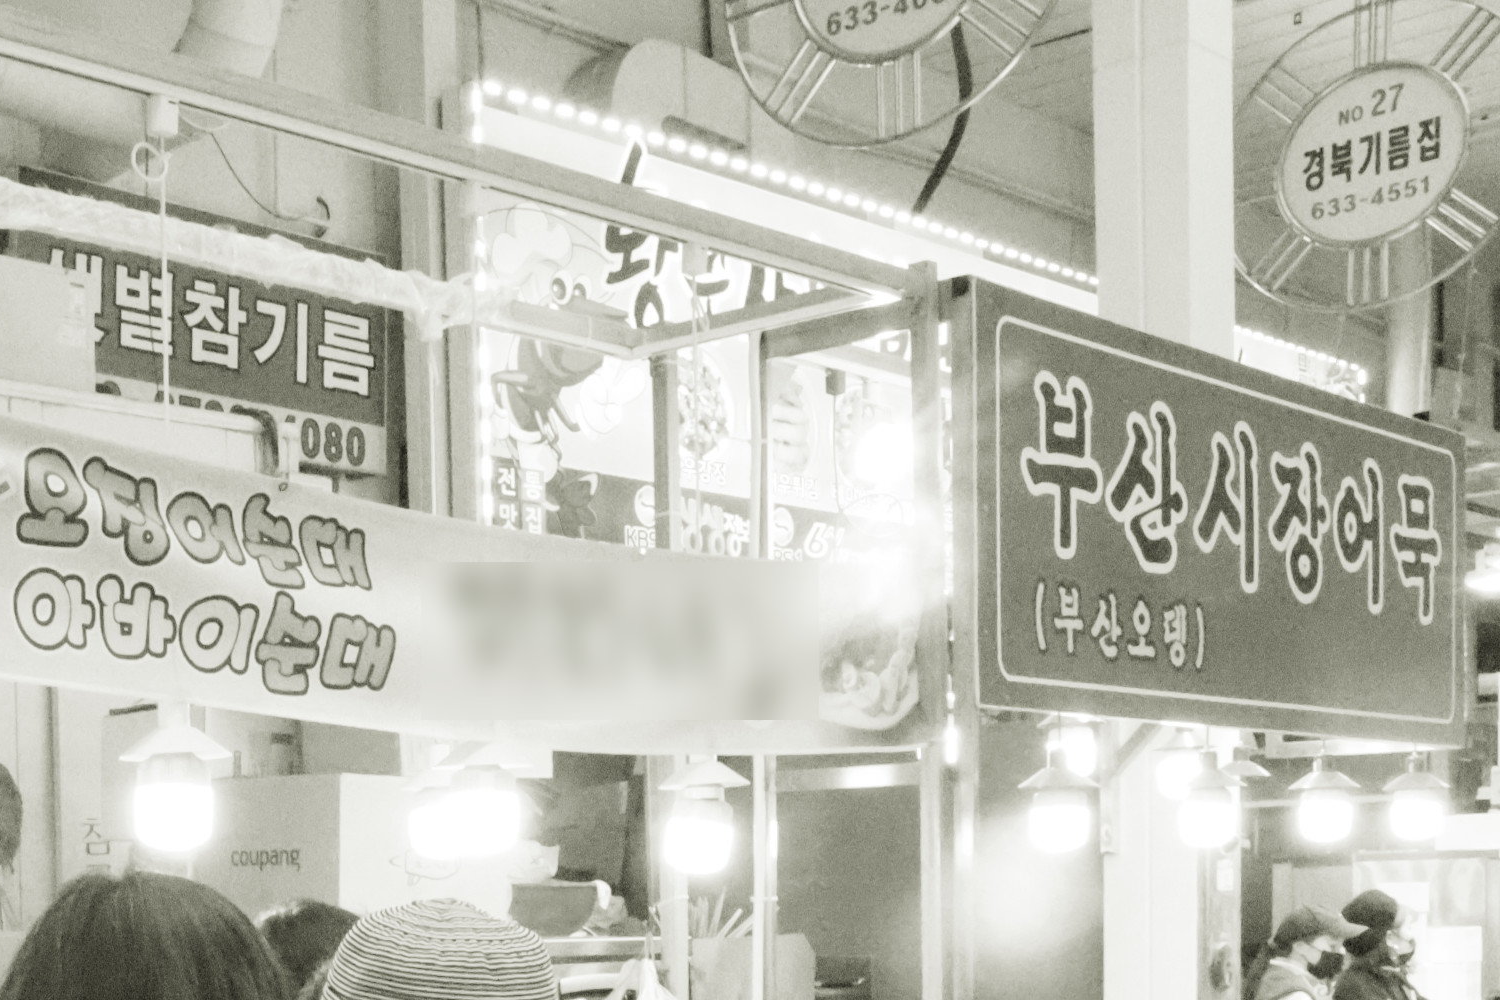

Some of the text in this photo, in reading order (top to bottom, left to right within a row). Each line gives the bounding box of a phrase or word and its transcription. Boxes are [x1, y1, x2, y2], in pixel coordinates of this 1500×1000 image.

[1338, 83, 1405, 126] NO 27
[1302, 116, 1441, 192] 경북기름집
[1311, 176, 1431, 220] 633-4551
[16, 446, 372, 592] 오징어순대
[497, 466, 544, 500] 전통
[1021, 371, 1441, 625] 부산시장어묵
[12, 566, 397, 695] 아바이순대
[1035, 582, 1205, 669] (부산오뎅)
[230, 846, 300, 872] coupang
